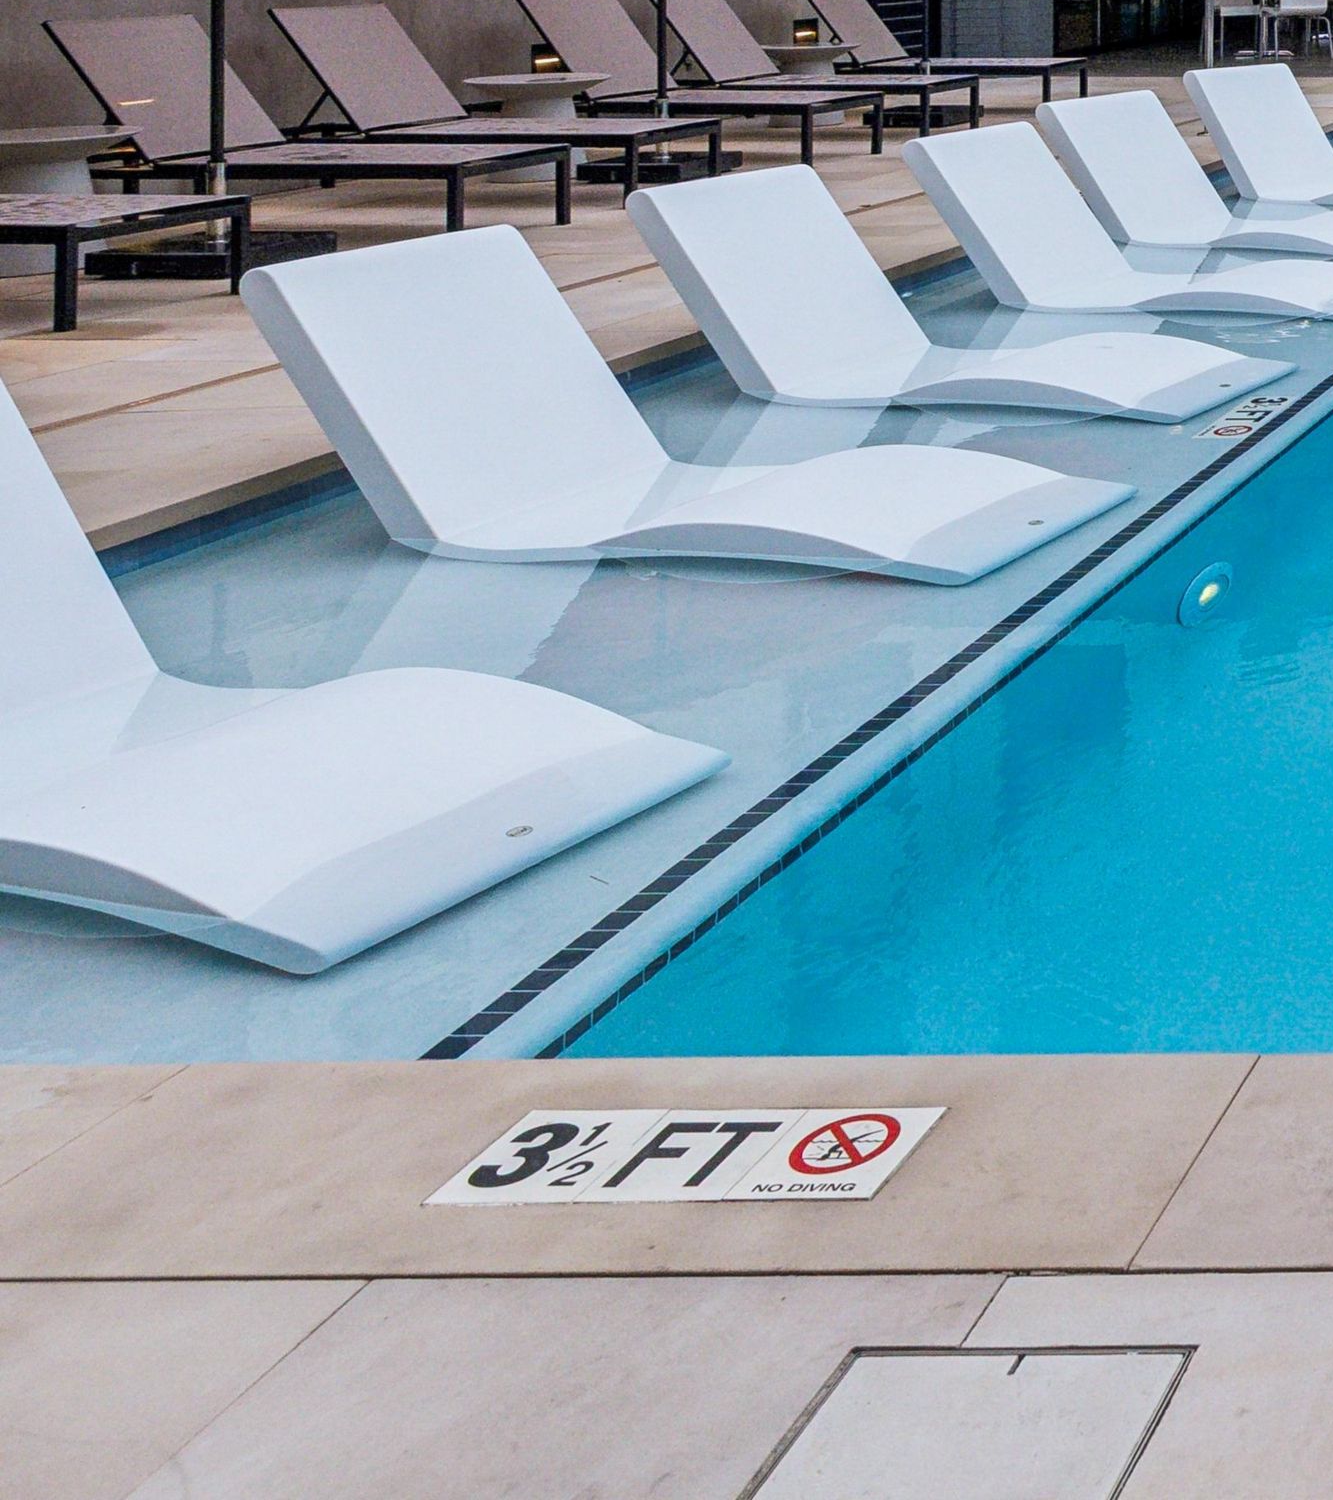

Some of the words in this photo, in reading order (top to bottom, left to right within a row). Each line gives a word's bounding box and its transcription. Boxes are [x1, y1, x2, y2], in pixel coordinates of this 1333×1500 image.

[1225, 410, 1274, 423] FT
[601, 1121, 784, 1189] FT
[751, 1183, 785, 1194] NO
[786, 1182, 858, 1194] DIVING
